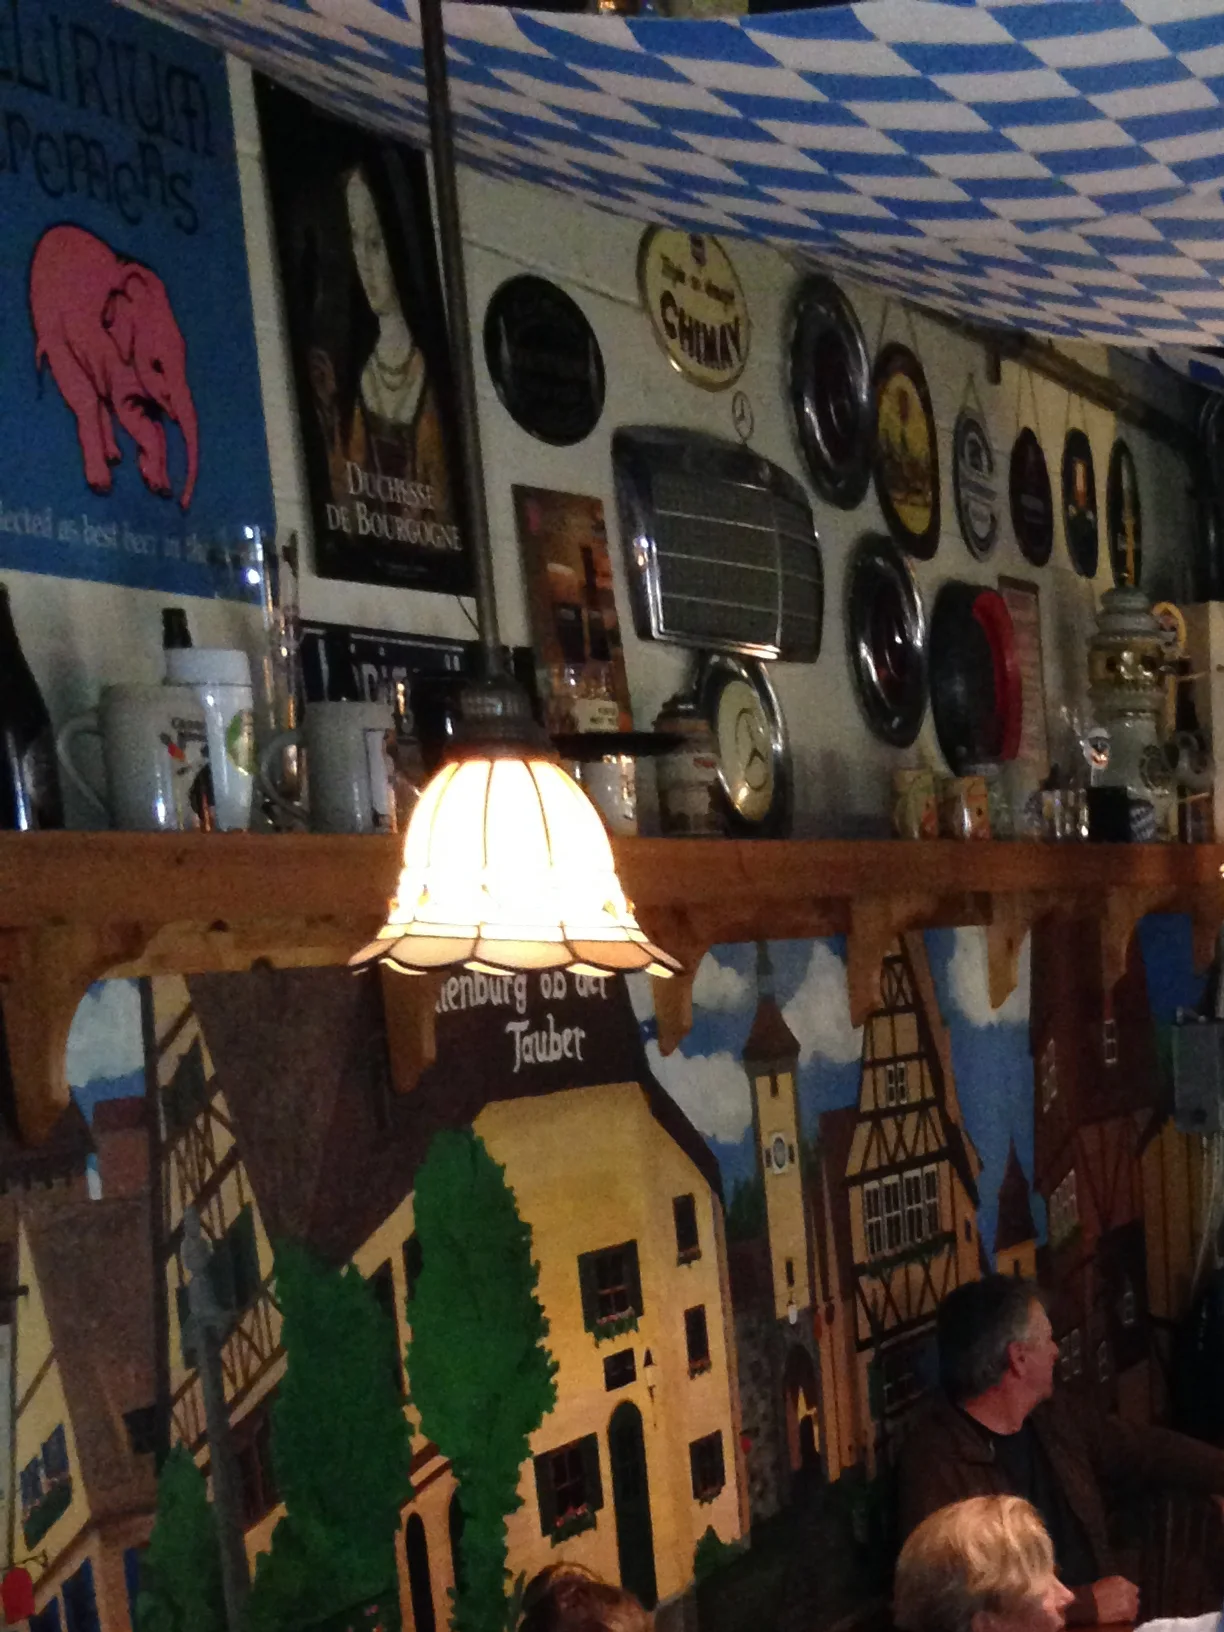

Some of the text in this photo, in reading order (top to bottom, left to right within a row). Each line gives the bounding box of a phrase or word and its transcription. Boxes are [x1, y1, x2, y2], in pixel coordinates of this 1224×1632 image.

[0, 0, 214, 157] LIRIUM
[660, 290, 743, 371] CHIMAY
[504, 1012, 588, 1075] Tauber
